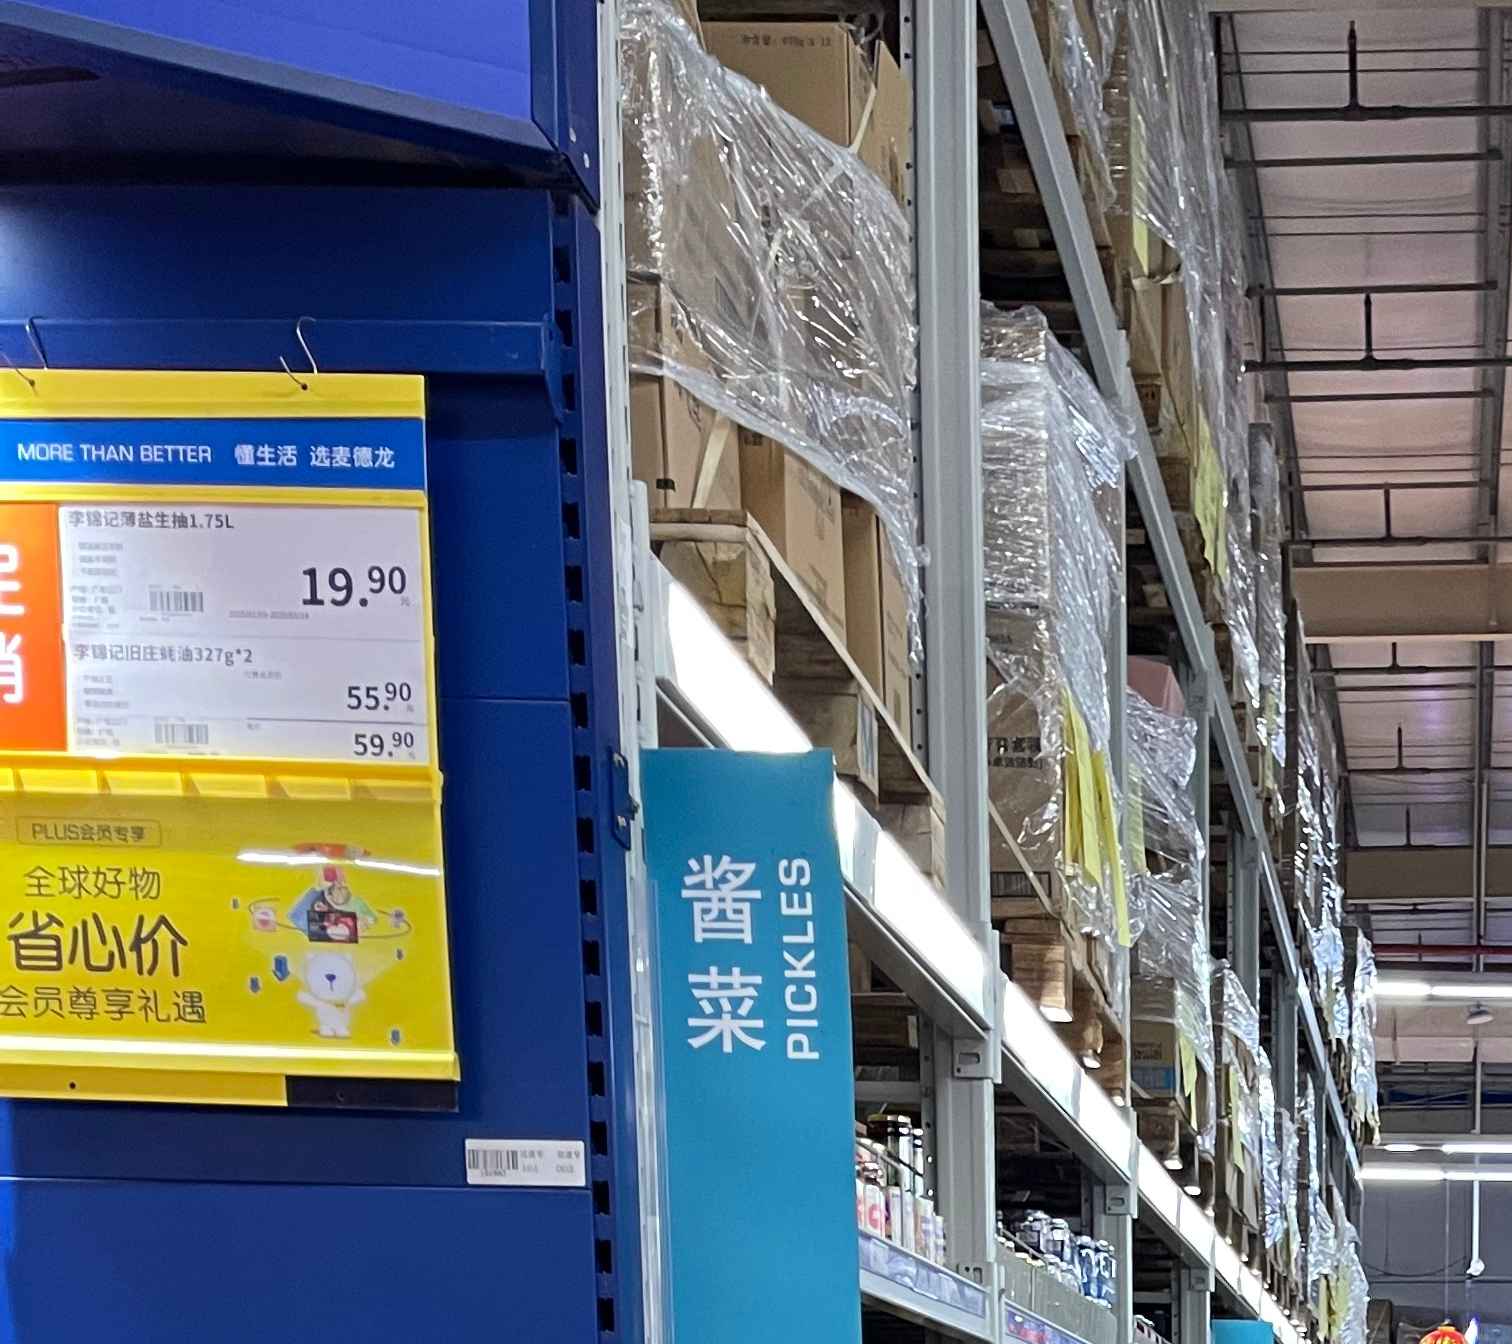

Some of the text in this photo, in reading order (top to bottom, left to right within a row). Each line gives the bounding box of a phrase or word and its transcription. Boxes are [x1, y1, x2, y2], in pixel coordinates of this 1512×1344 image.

[17, 444, 212, 463] MORE THAN BETTER
[234, 444, 395, 468] 懂生活 选麦德龙
[302, 566, 407, 607] 19.90
[347, 682, 412, 711] 55.90
[354, 732, 414, 758] 59.90
[32, 823, 145, 842] PLUS会员专享
[24, 865, 161, 900] 全球好物
[7, 910, 188, 977] 省心价
[681, 854, 767, 1053] 酱菜
[778, 857, 820, 1060] PICKLES
[0, 985, 207, 1024] 会员尊享礼遇
